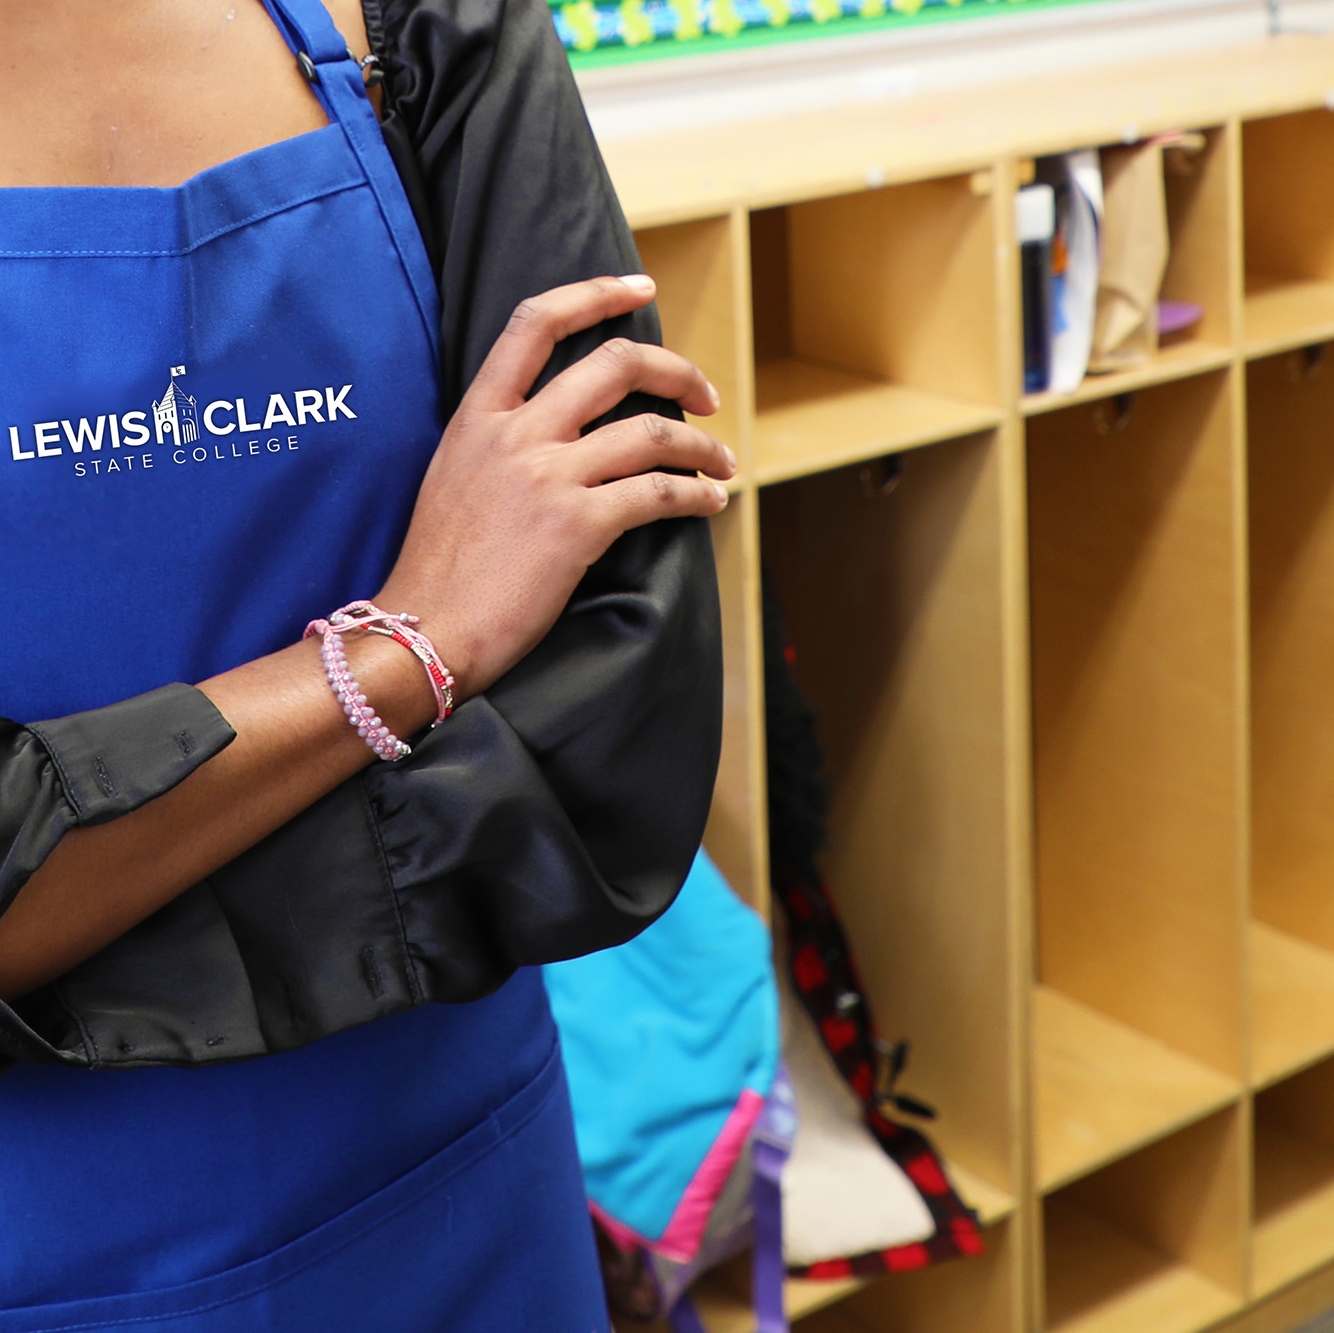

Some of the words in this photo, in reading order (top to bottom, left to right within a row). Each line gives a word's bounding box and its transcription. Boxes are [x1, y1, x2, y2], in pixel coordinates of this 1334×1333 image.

[8, 411, 150, 461] LEWIS
[203, 384, 358, 436] CLARK
[74, 454, 154, 477] STATE
[173, 435, 299, 464] COLLEGE
